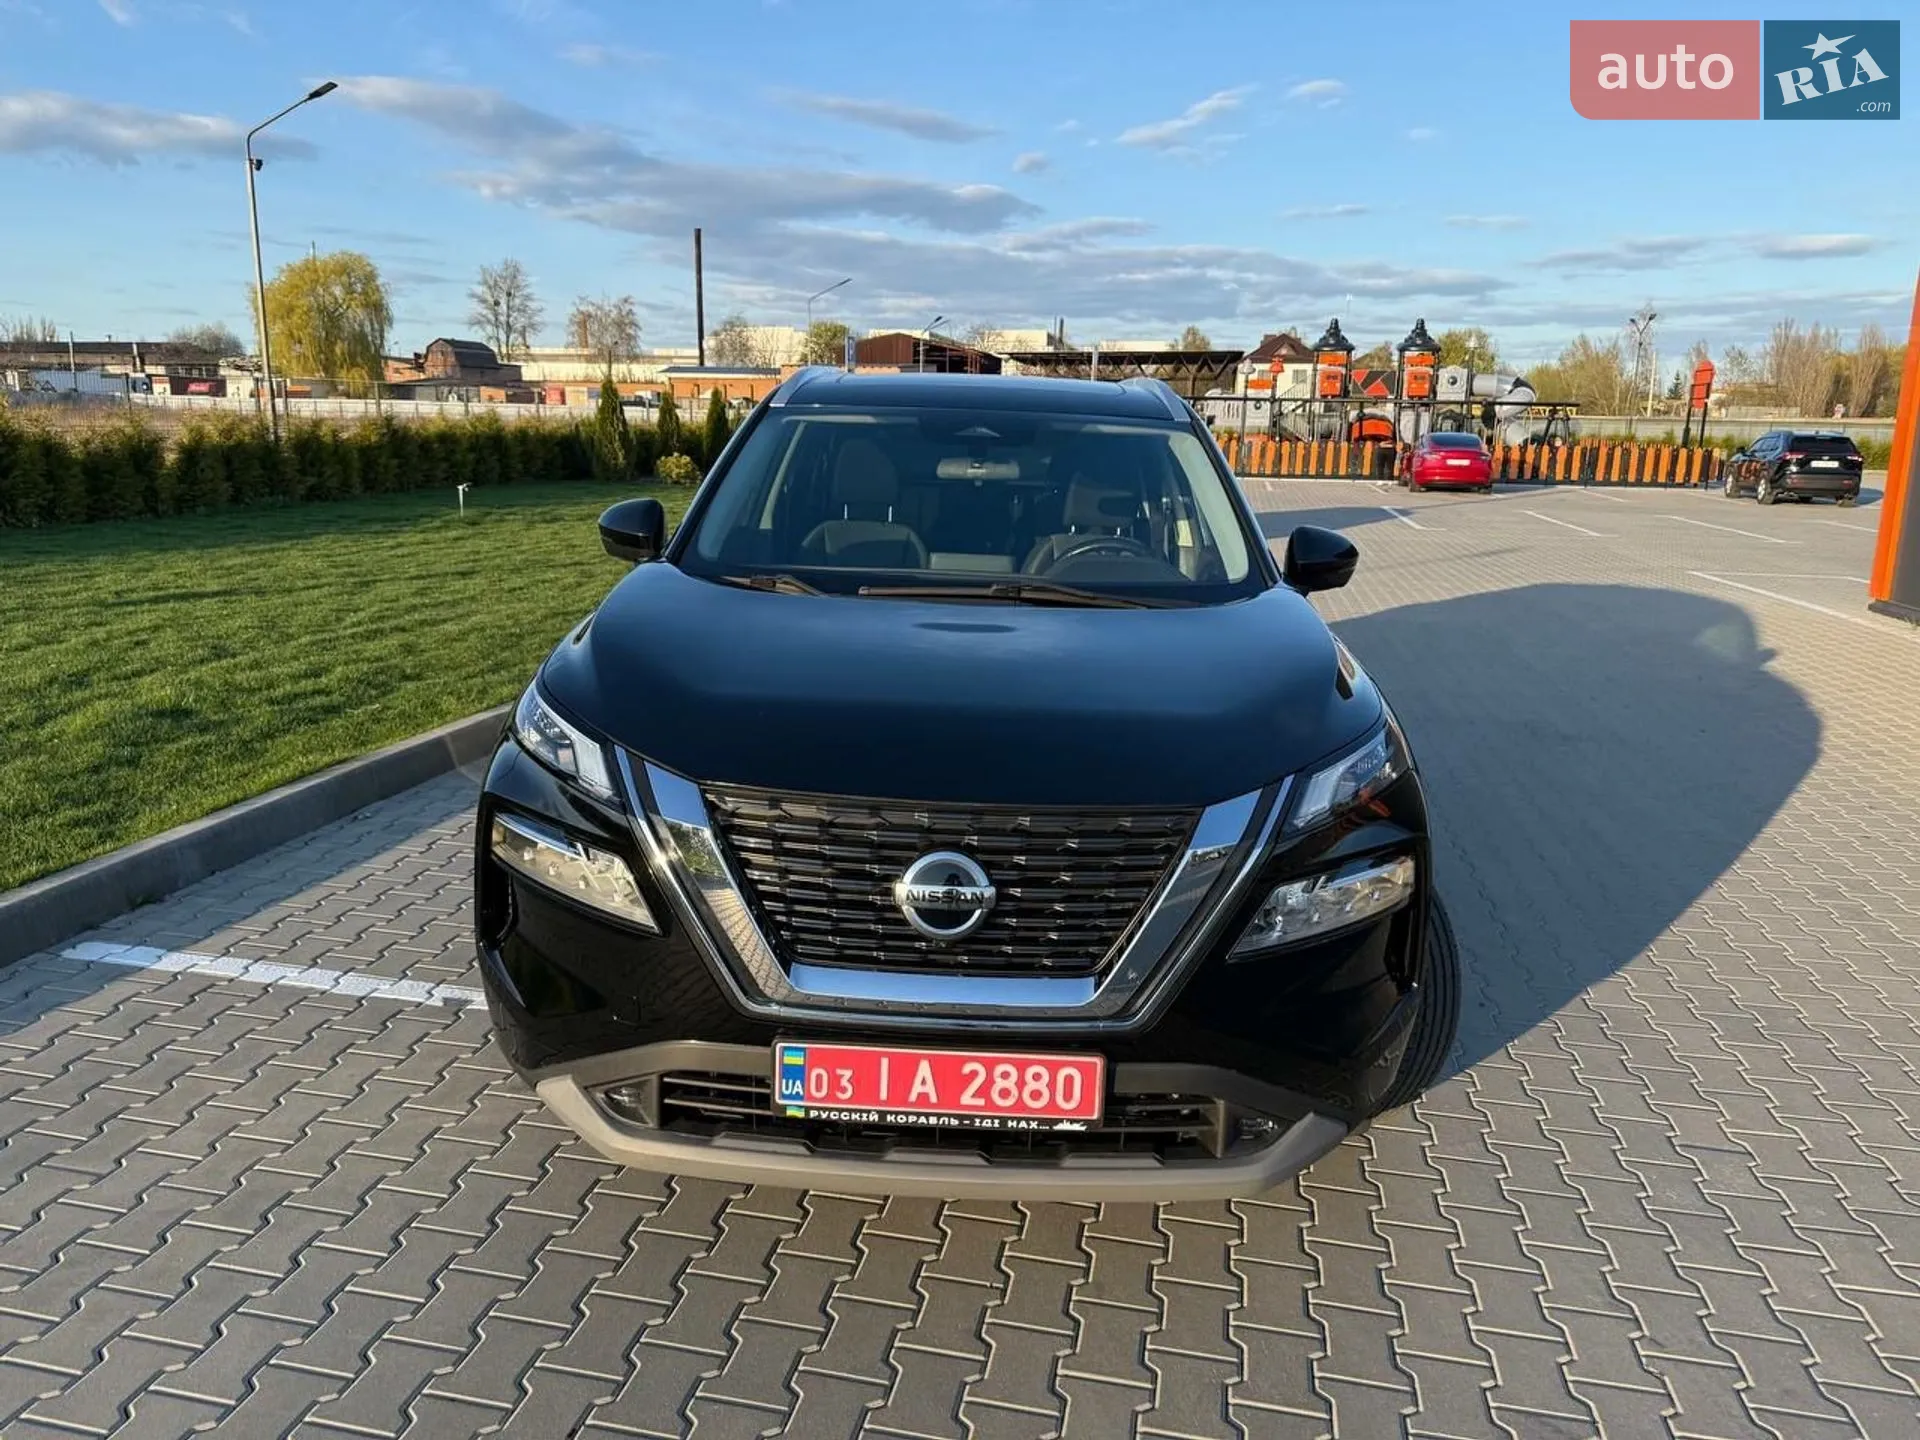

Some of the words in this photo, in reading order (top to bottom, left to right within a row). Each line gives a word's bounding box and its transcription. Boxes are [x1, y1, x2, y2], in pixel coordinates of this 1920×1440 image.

[905, 889, 985, 904] NISSAN
[781, 1079, 804, 1095] UA
[809, 1067, 854, 1100] 03
[960, 1061, 1083, 1111] 2880
[886, 1113, 959, 1127] КОРАБЛЬ
